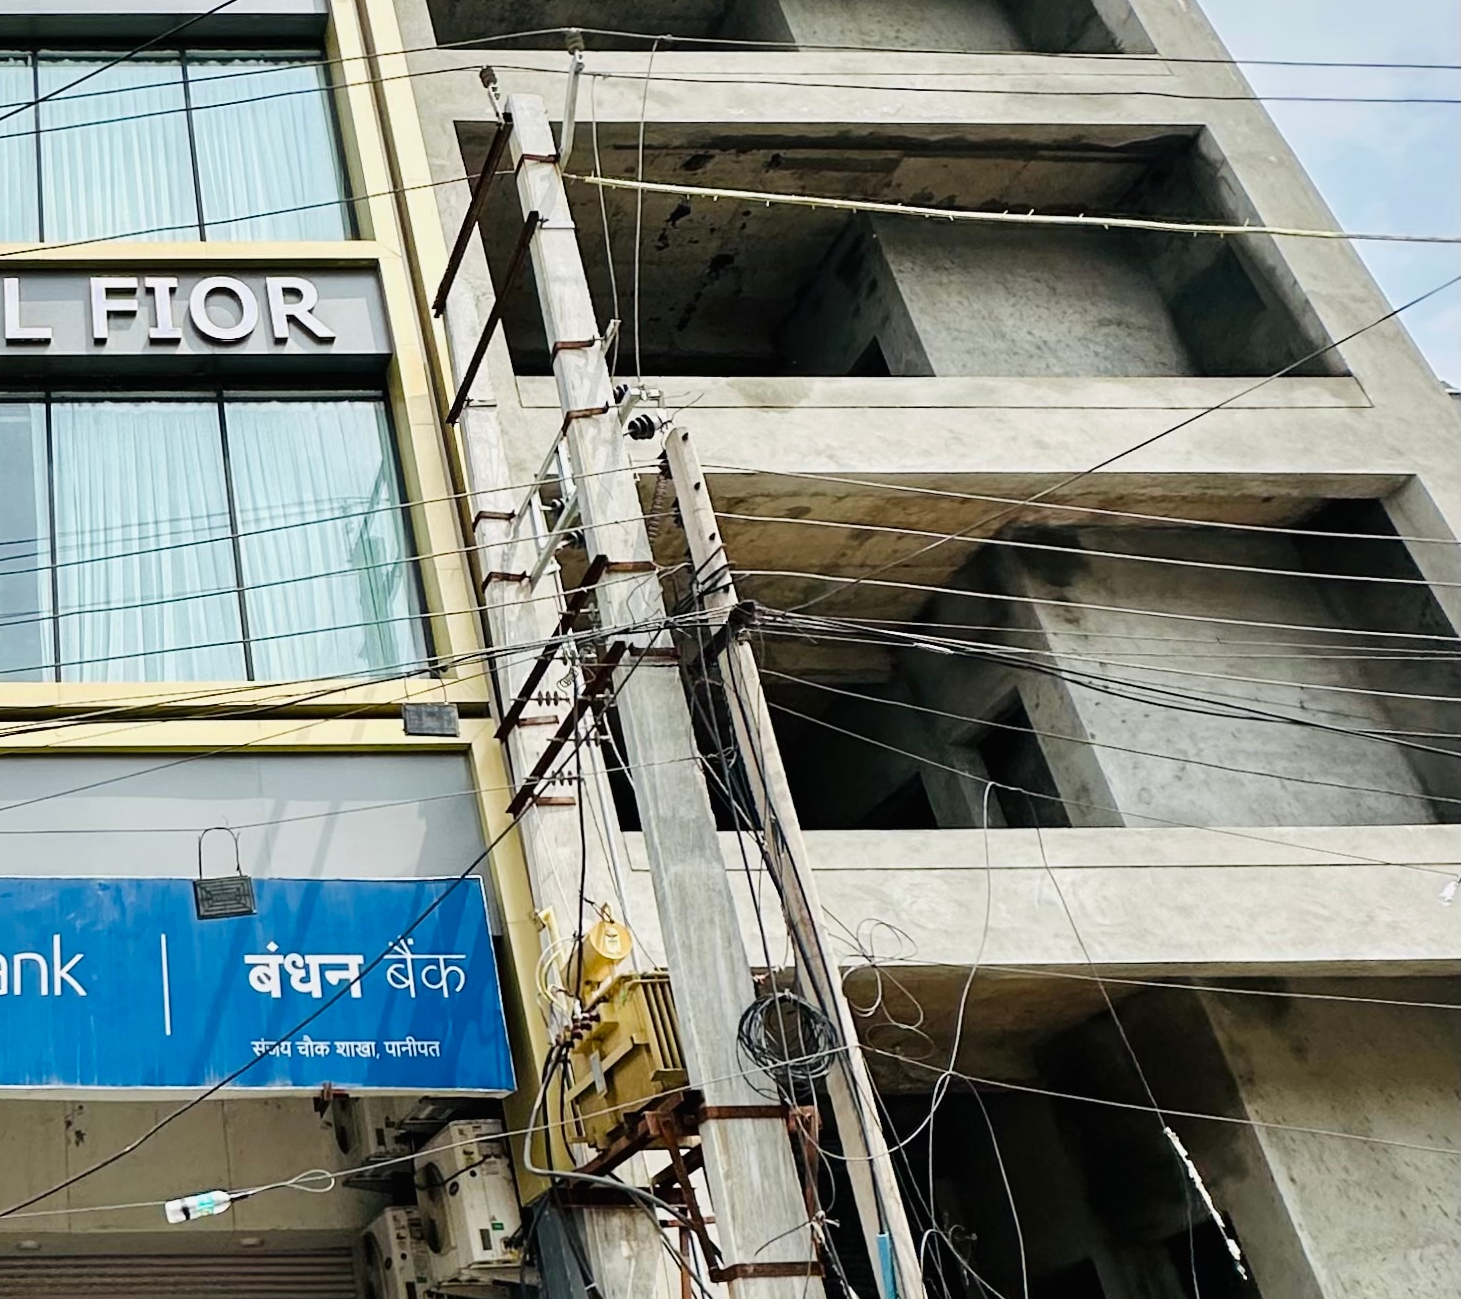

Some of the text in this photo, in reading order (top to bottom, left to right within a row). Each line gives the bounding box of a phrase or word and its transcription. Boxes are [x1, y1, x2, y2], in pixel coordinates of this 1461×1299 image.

[90, 275, 337, 344] FIOR
[244, 935, 467, 999] बंधन बैंक
[295, 1034, 331, 1058] चौक
[334, 1040, 381, 1060] शाखा,
[383, 1035, 441, 1058] पानीपत
